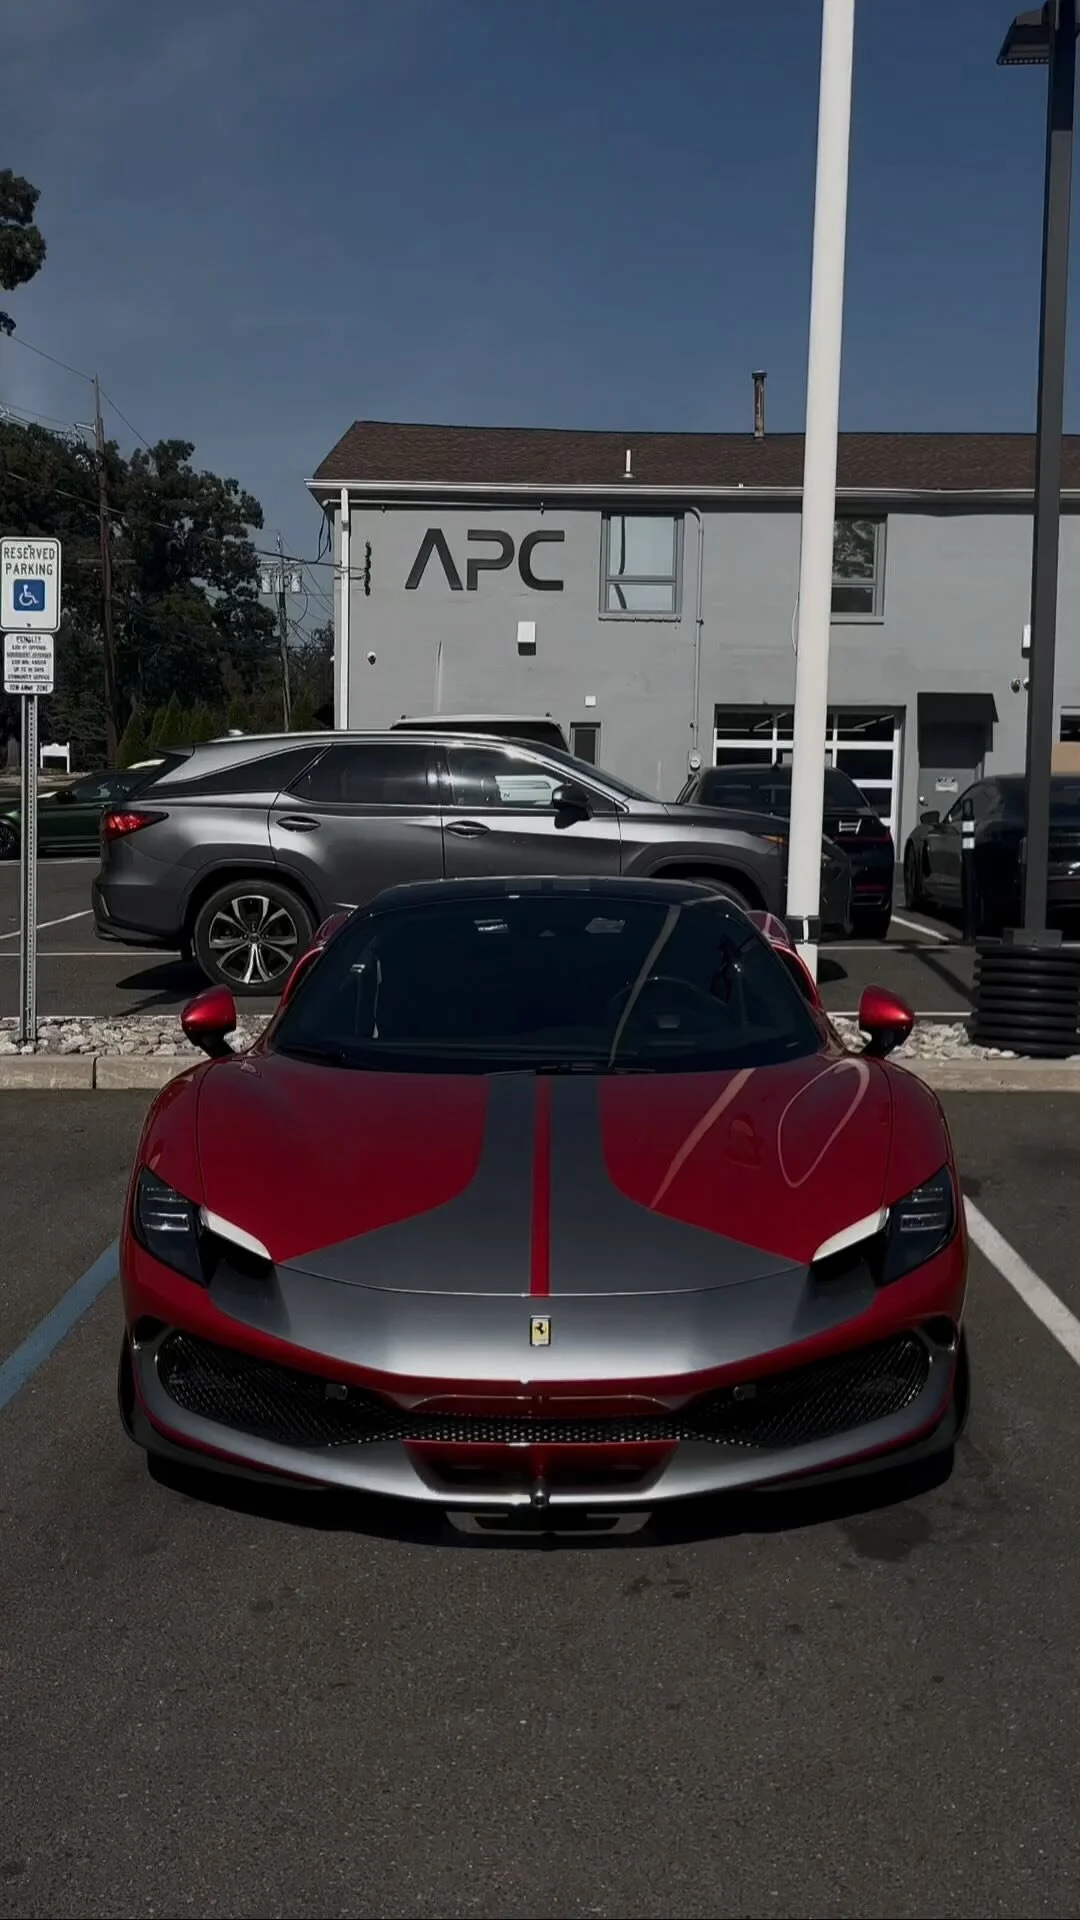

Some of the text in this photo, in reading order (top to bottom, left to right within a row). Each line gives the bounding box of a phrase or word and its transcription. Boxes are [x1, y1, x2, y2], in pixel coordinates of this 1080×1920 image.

[4, 547, 55, 560] RESERVED
[405, 528, 565, 591] APC
[5, 562, 53, 576] PARKING
